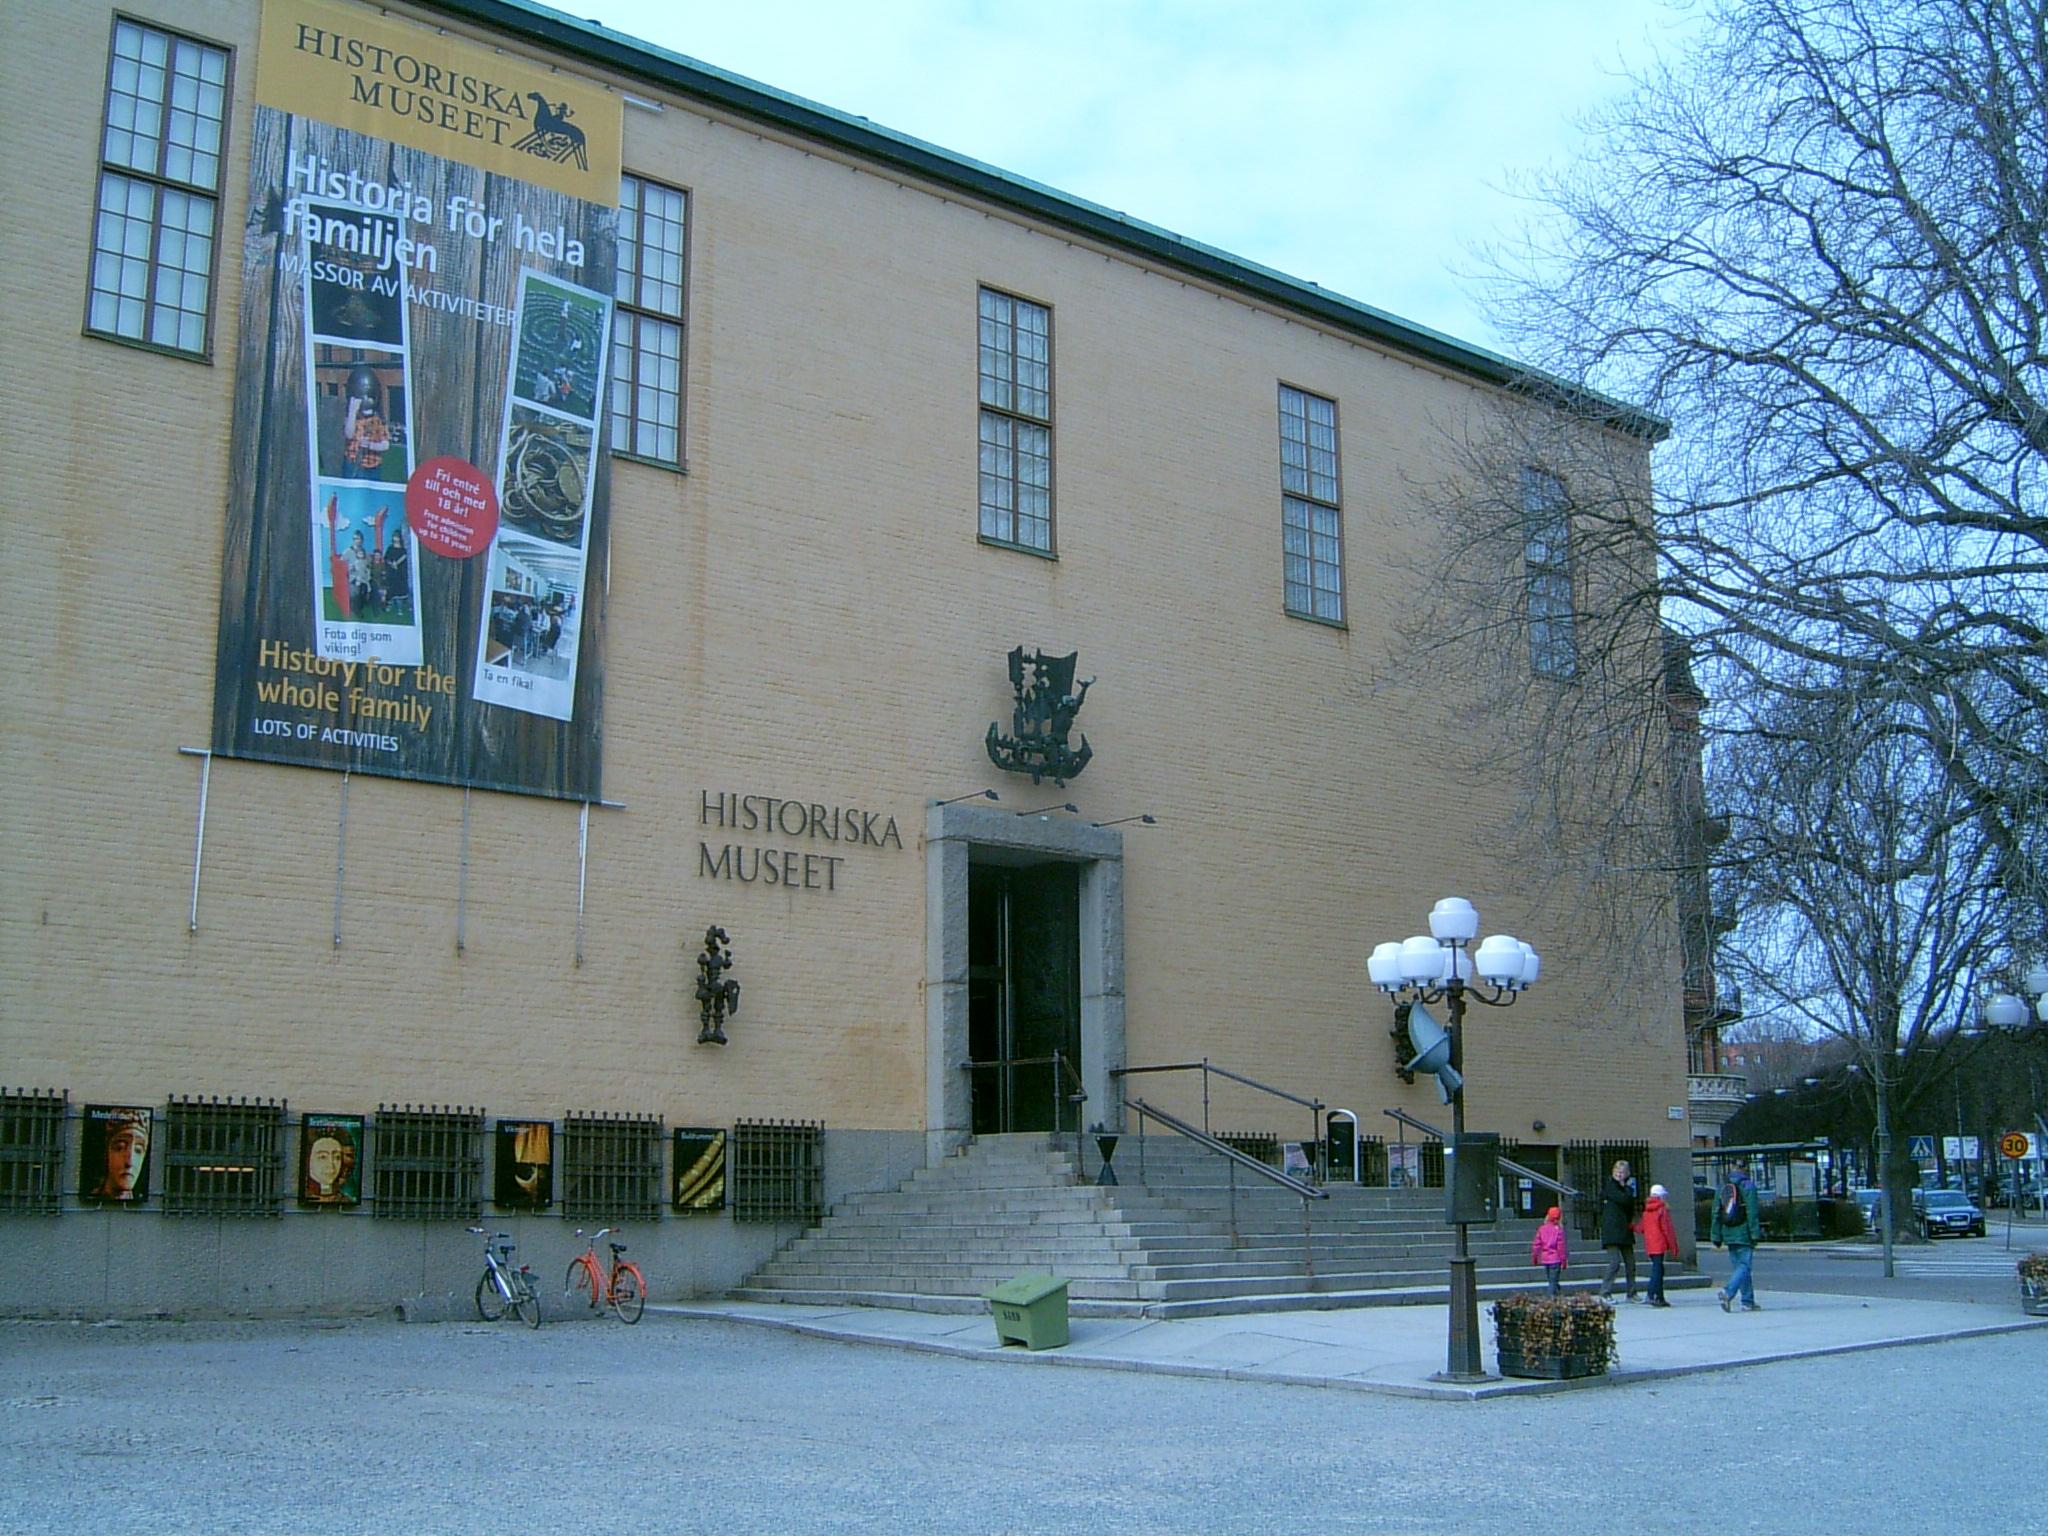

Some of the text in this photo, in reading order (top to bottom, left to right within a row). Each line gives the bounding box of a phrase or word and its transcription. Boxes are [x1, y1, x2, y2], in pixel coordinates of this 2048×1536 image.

[295, 23, 529, 120] HISTORISKA
[350, 74, 511, 146] MUSEET
[287, 149, 585, 268] Historia för hela
[282, 198, 437, 273] familjen
[279, 252, 517, 327] MASSOR AV AKTIVITETER
[425, 479, 440, 492] till
[442, 487, 461, 500] och
[436, 468, 451, 482] Fri
[438, 497, 451, 510] 18
[324, 627, 392, 643] Fota dig som
[325, 642, 361, 656] viking!
[259, 639, 457, 695] History for the
[483, 669, 534, 690] Ta en fika!
[257, 677, 432, 733] whole family
[254, 718, 399, 752] LOTS OF ACTIVITIES
[702, 789, 904, 850] HISTORISKA
[699, 842, 845, 890] MUSEET
[2005, 1139, 2025, 1152] 30
